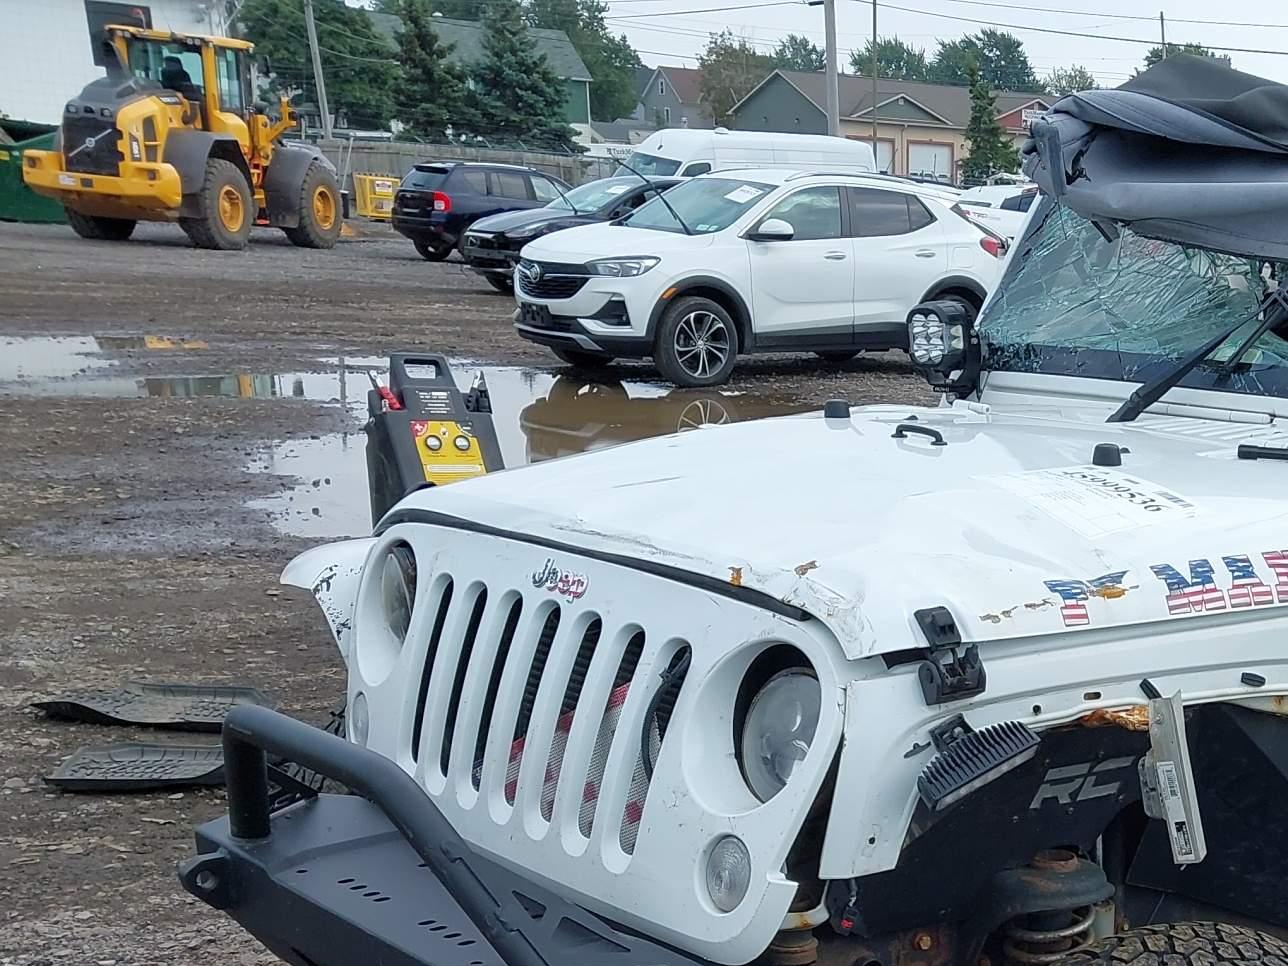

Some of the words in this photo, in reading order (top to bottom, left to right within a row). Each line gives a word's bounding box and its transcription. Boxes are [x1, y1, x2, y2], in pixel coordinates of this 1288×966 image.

[1063, 471, 1169, 512] 45999536
[531, 557, 589, 604] Jeep
[1029, 755, 1137, 809] RC
